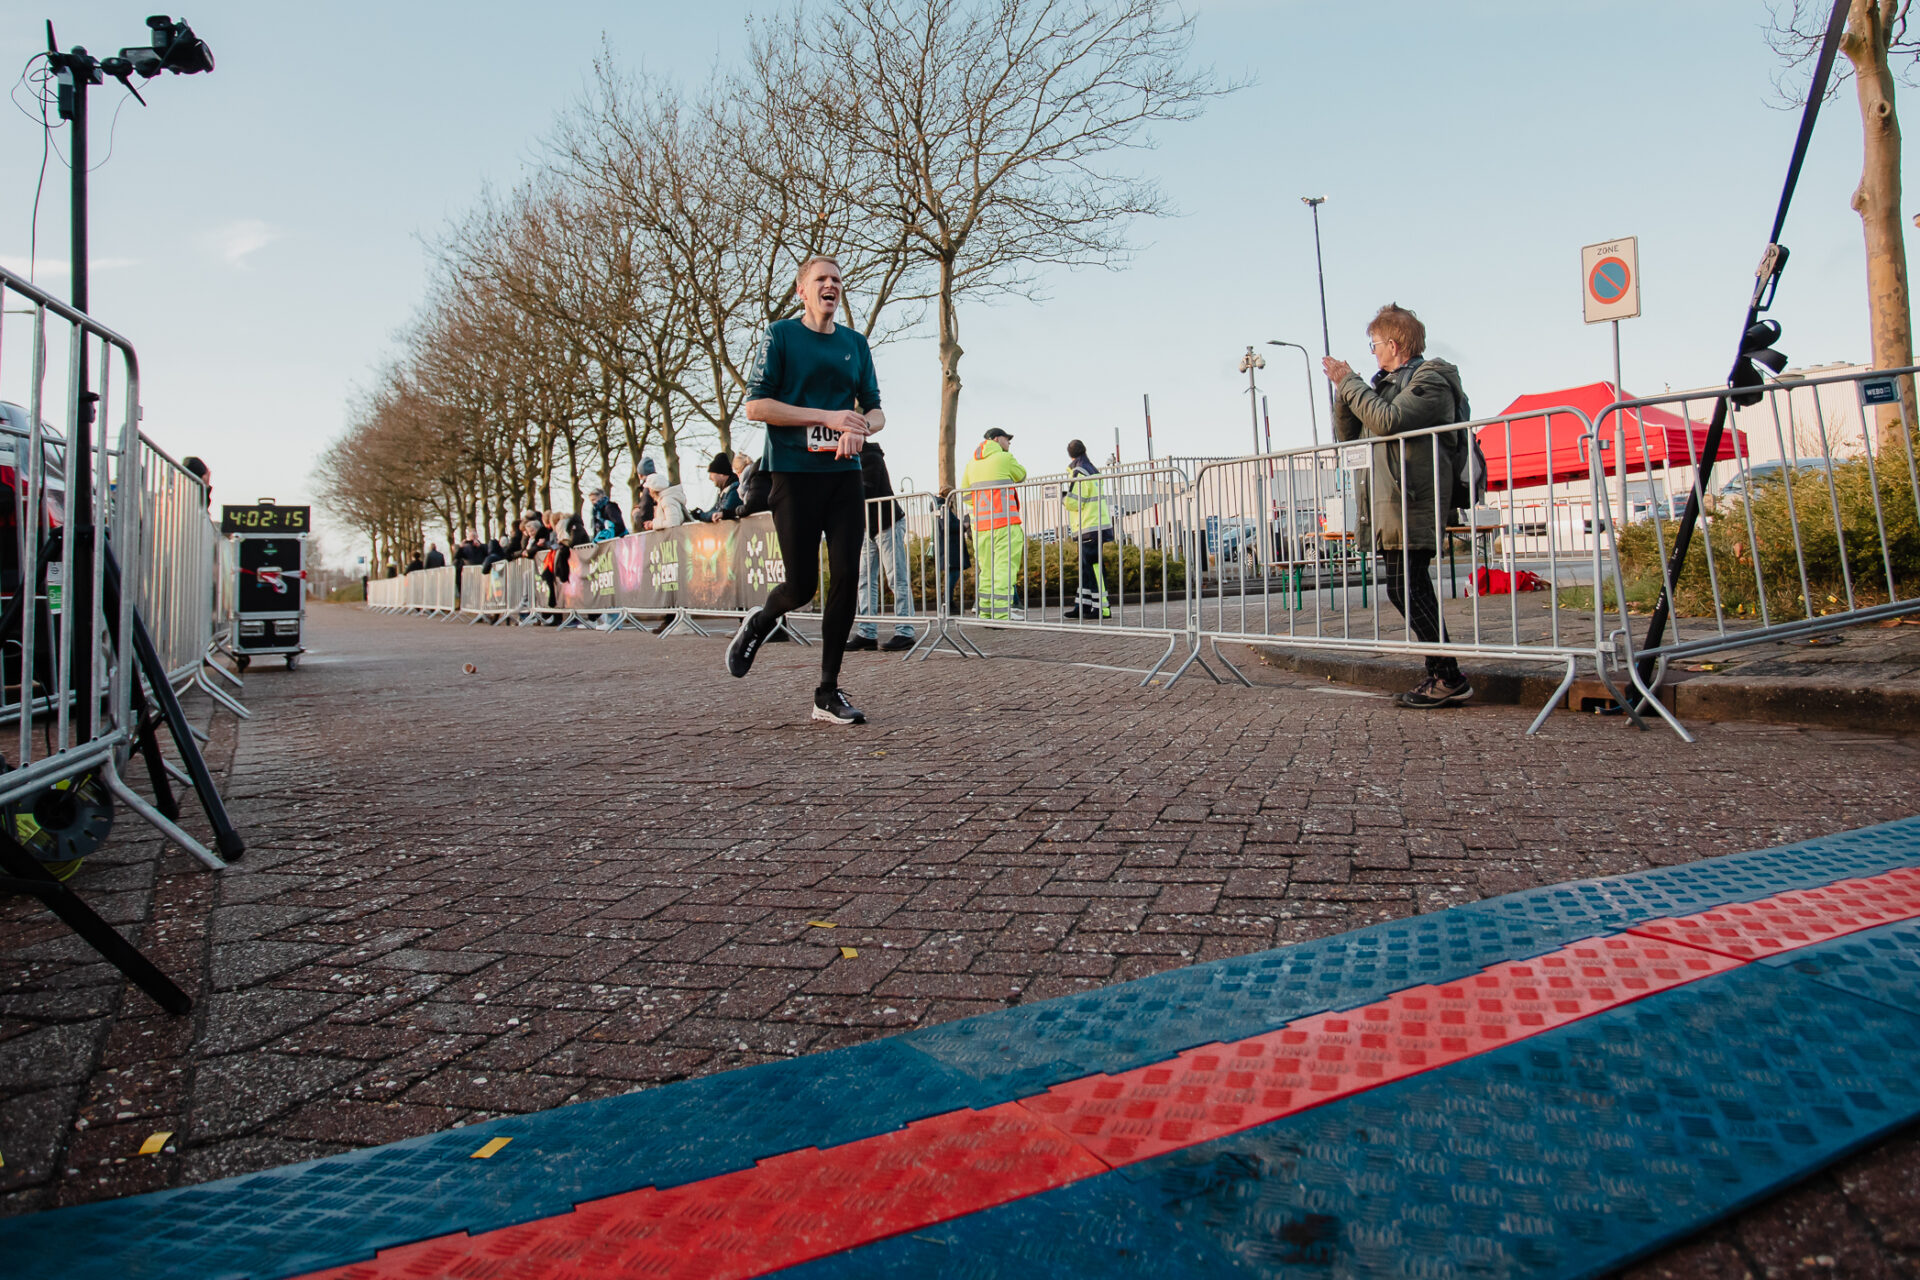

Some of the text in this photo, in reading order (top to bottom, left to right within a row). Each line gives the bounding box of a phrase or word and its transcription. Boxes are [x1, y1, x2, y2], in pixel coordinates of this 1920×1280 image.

[1597, 245, 1619, 256] ZONE
[811, 426, 845, 441] 405
[229, 511, 303, 527] 4:02:15
[765, 531, 783, 559] VA
[765, 560, 786, 582] EVE
